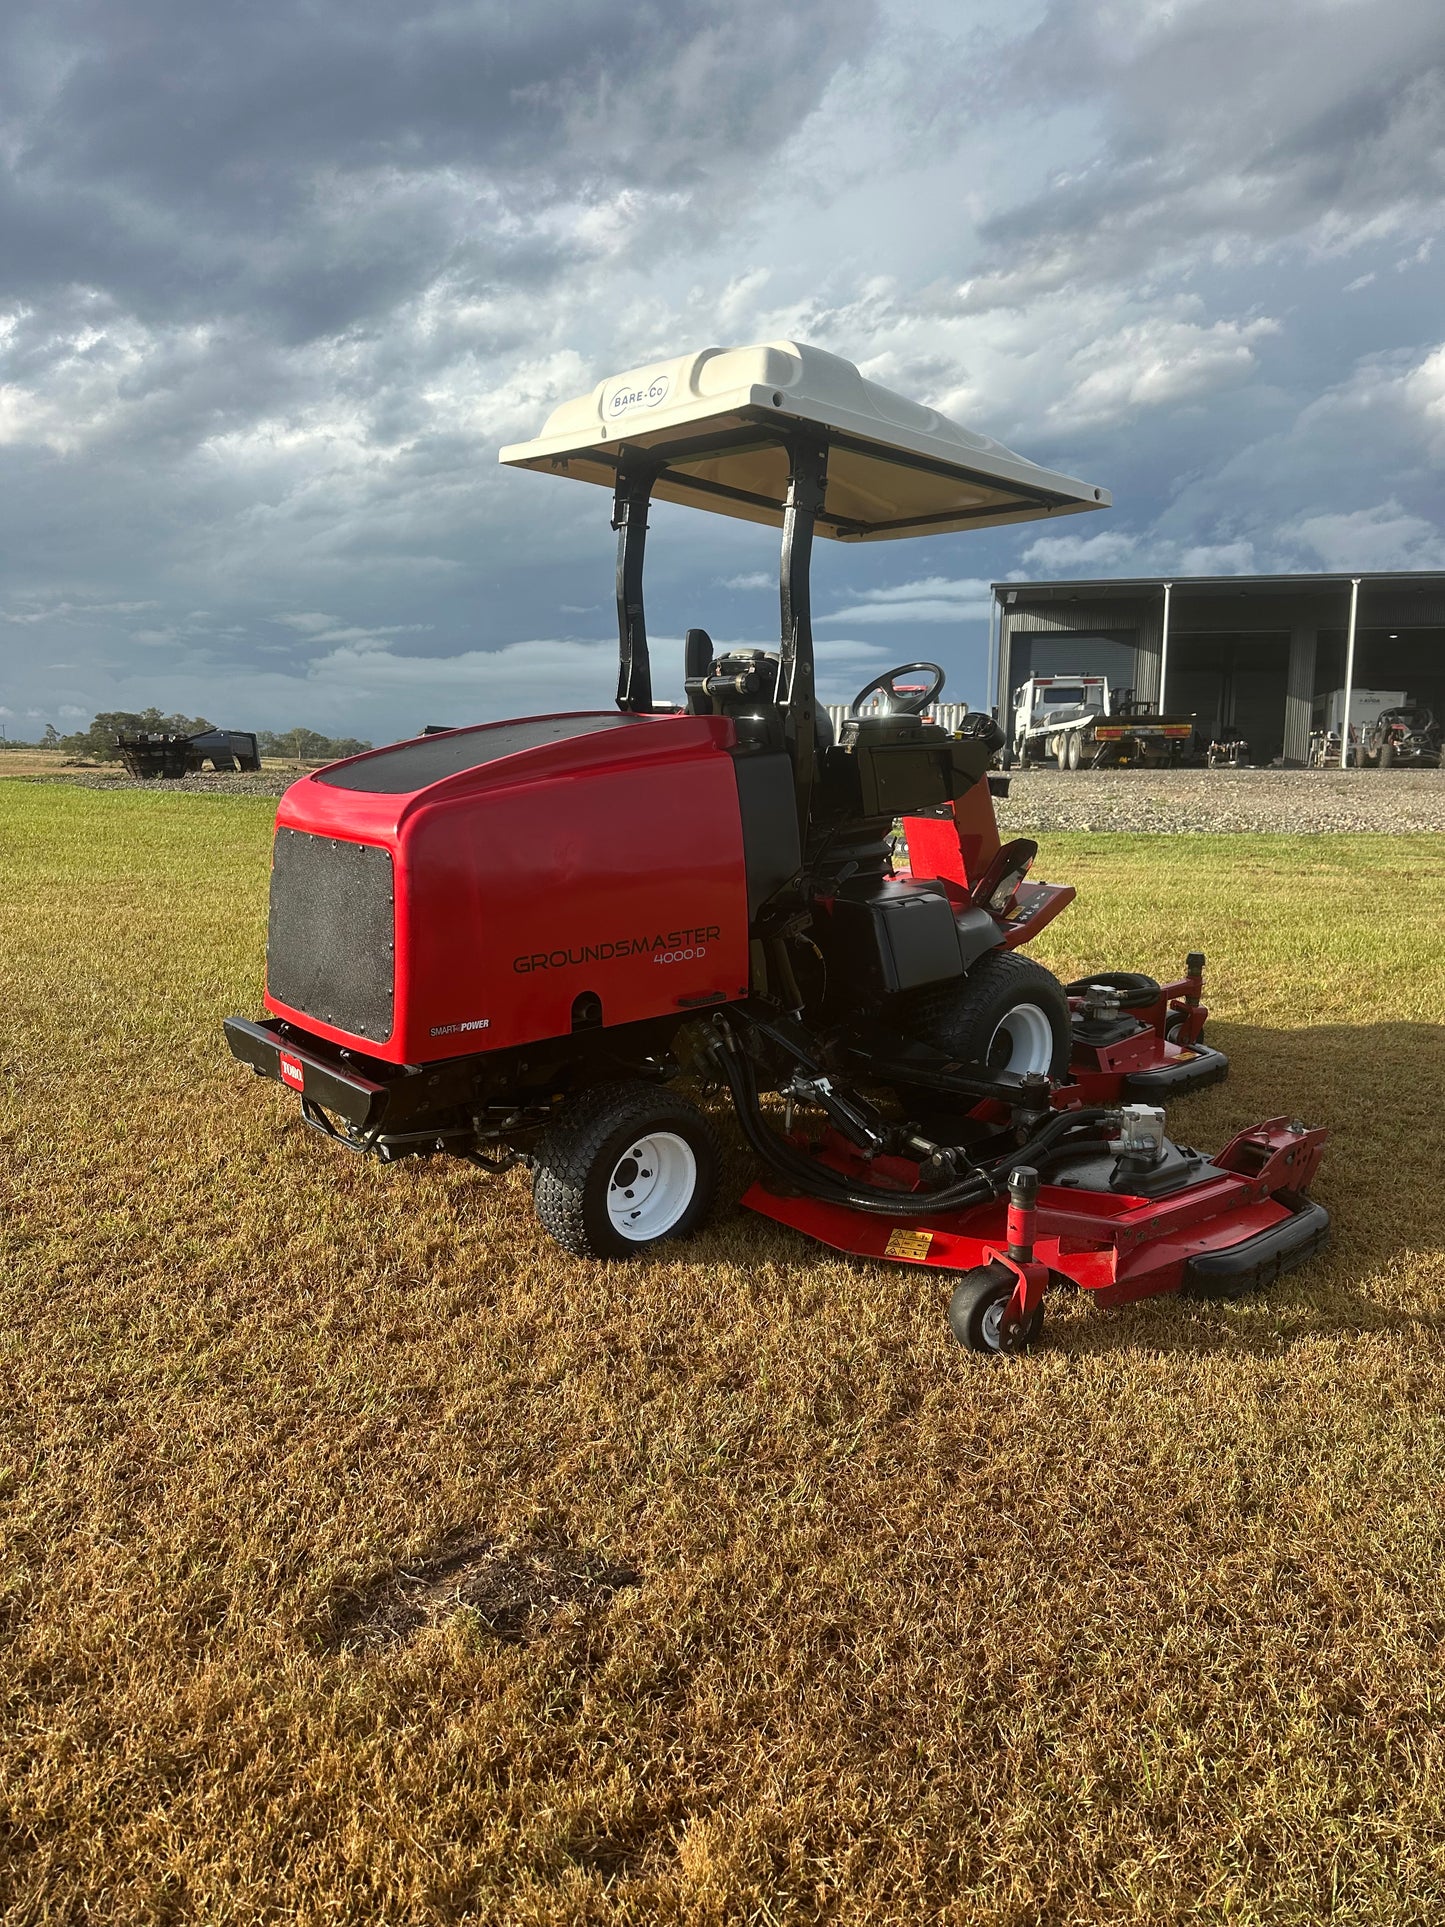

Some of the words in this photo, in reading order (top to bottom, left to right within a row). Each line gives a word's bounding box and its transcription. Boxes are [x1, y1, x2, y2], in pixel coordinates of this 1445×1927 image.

[513, 926, 721, 974] GROUNDSMASTER
[461, 1019, 489, 1032] POWER
[282, 1060, 303, 1082] TORO
